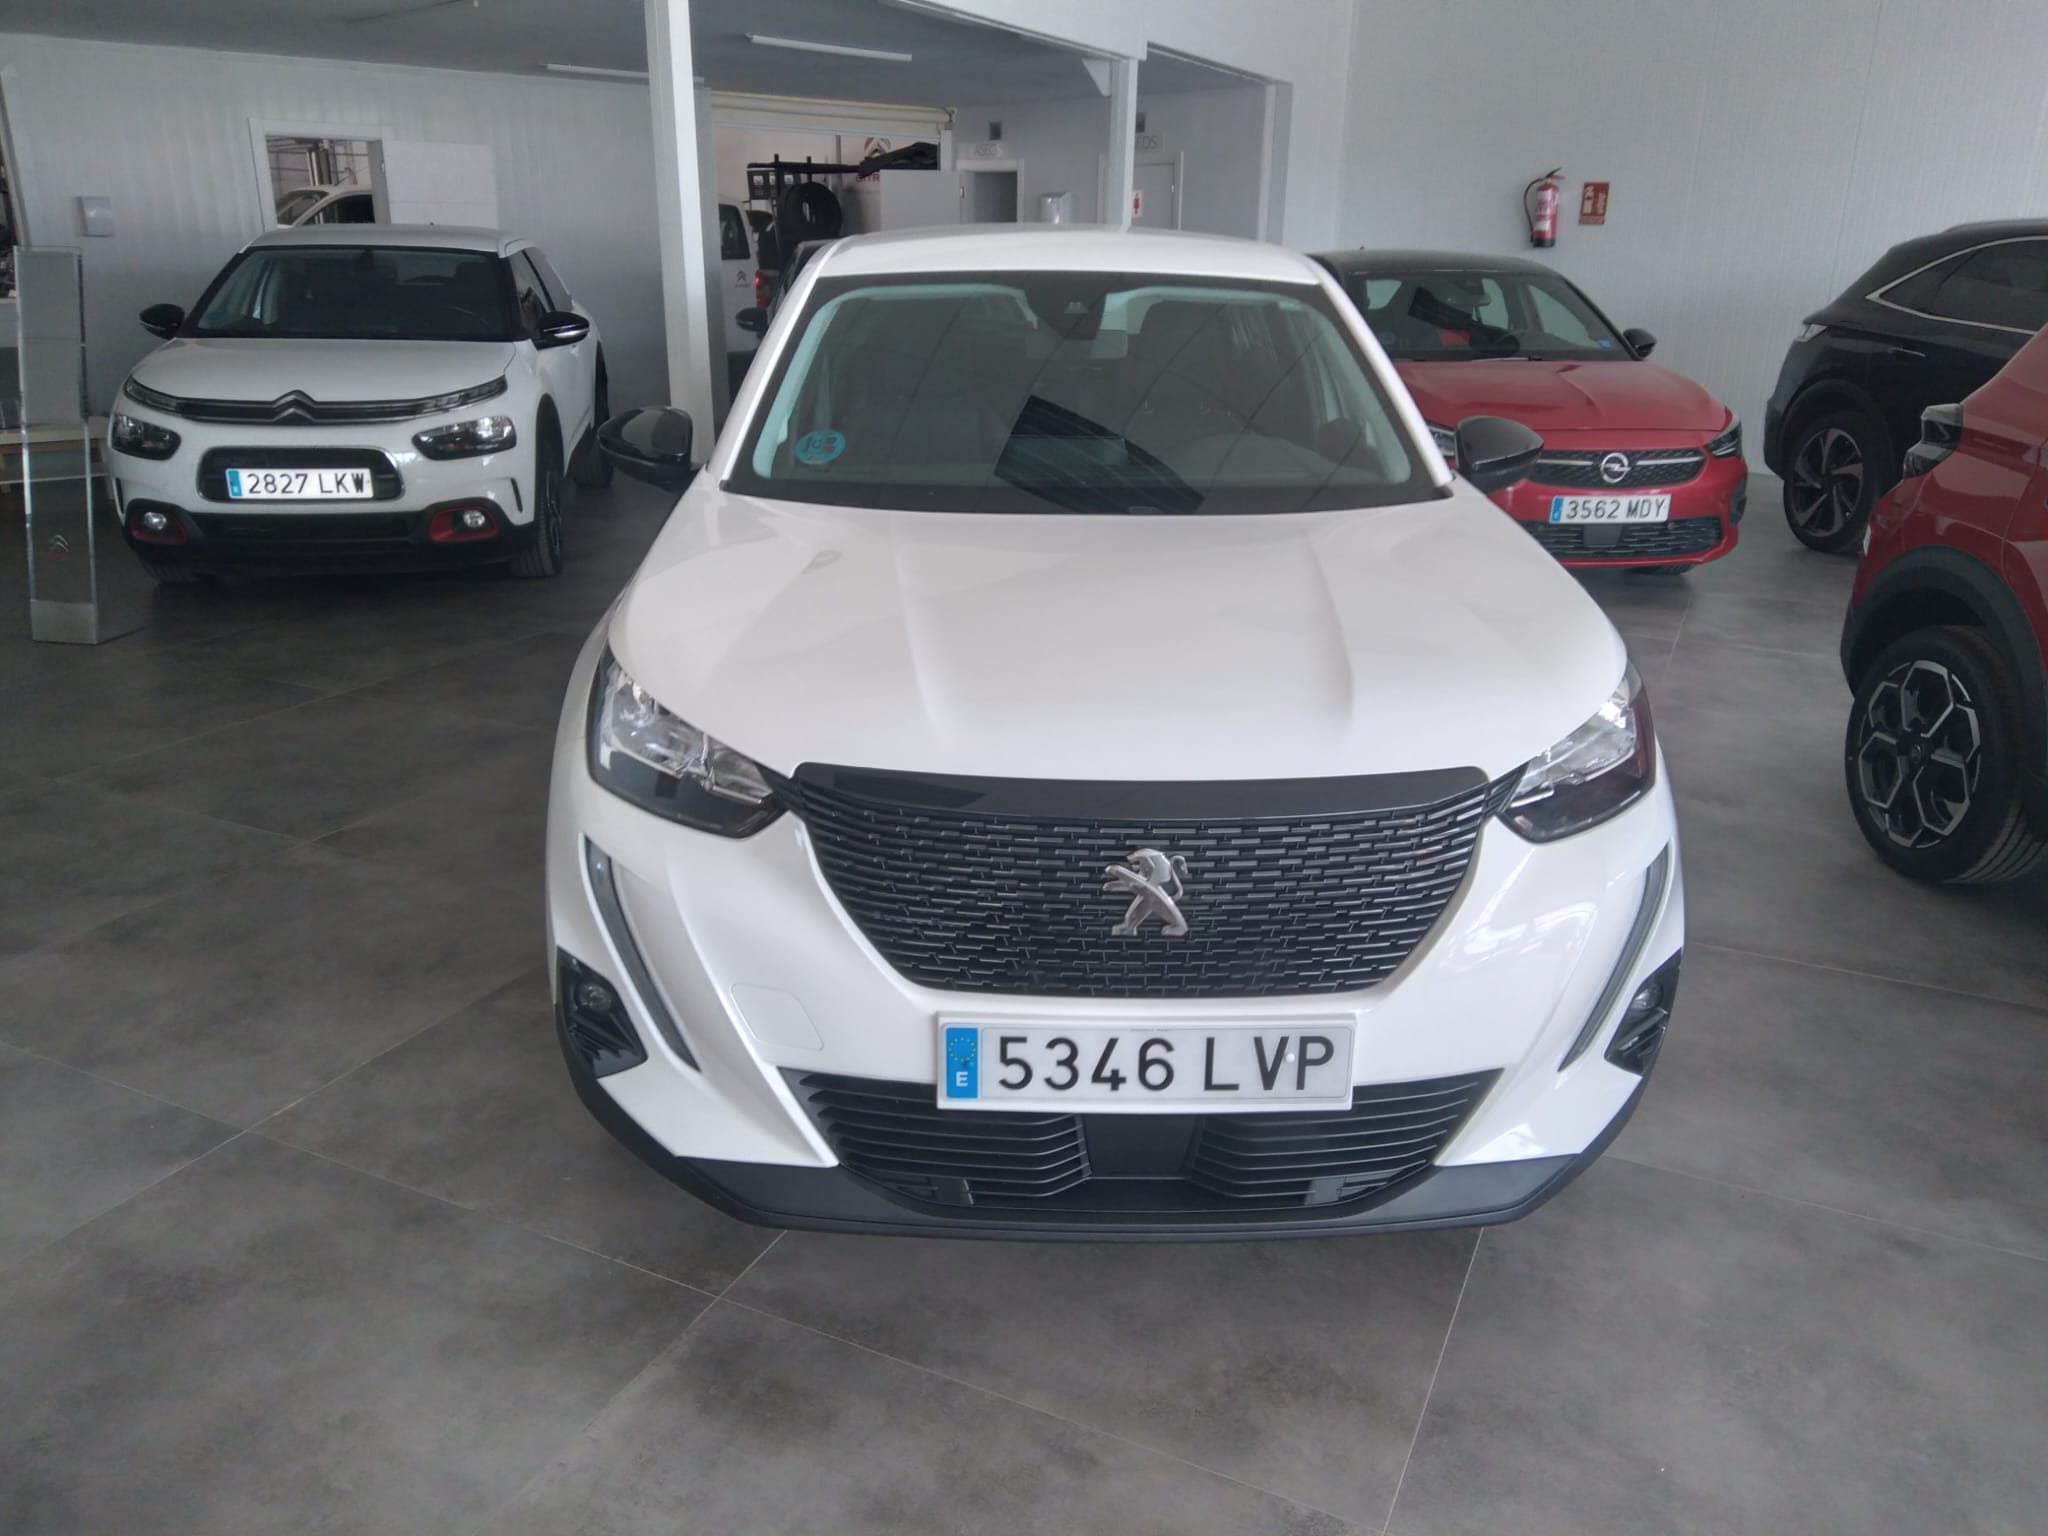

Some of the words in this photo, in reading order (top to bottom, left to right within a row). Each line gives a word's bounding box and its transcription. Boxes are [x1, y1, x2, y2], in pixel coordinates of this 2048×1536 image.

[247, 473, 308, 494] 2827
[318, 472, 364, 494] LKW
[1565, 500, 1620, 519] 3562
[1625, 499, 1666, 519] MDY
[998, 1036, 1175, 1091] 5346
[1203, 1036, 1334, 1091] LVP
[956, 1071, 968, 1087] E
